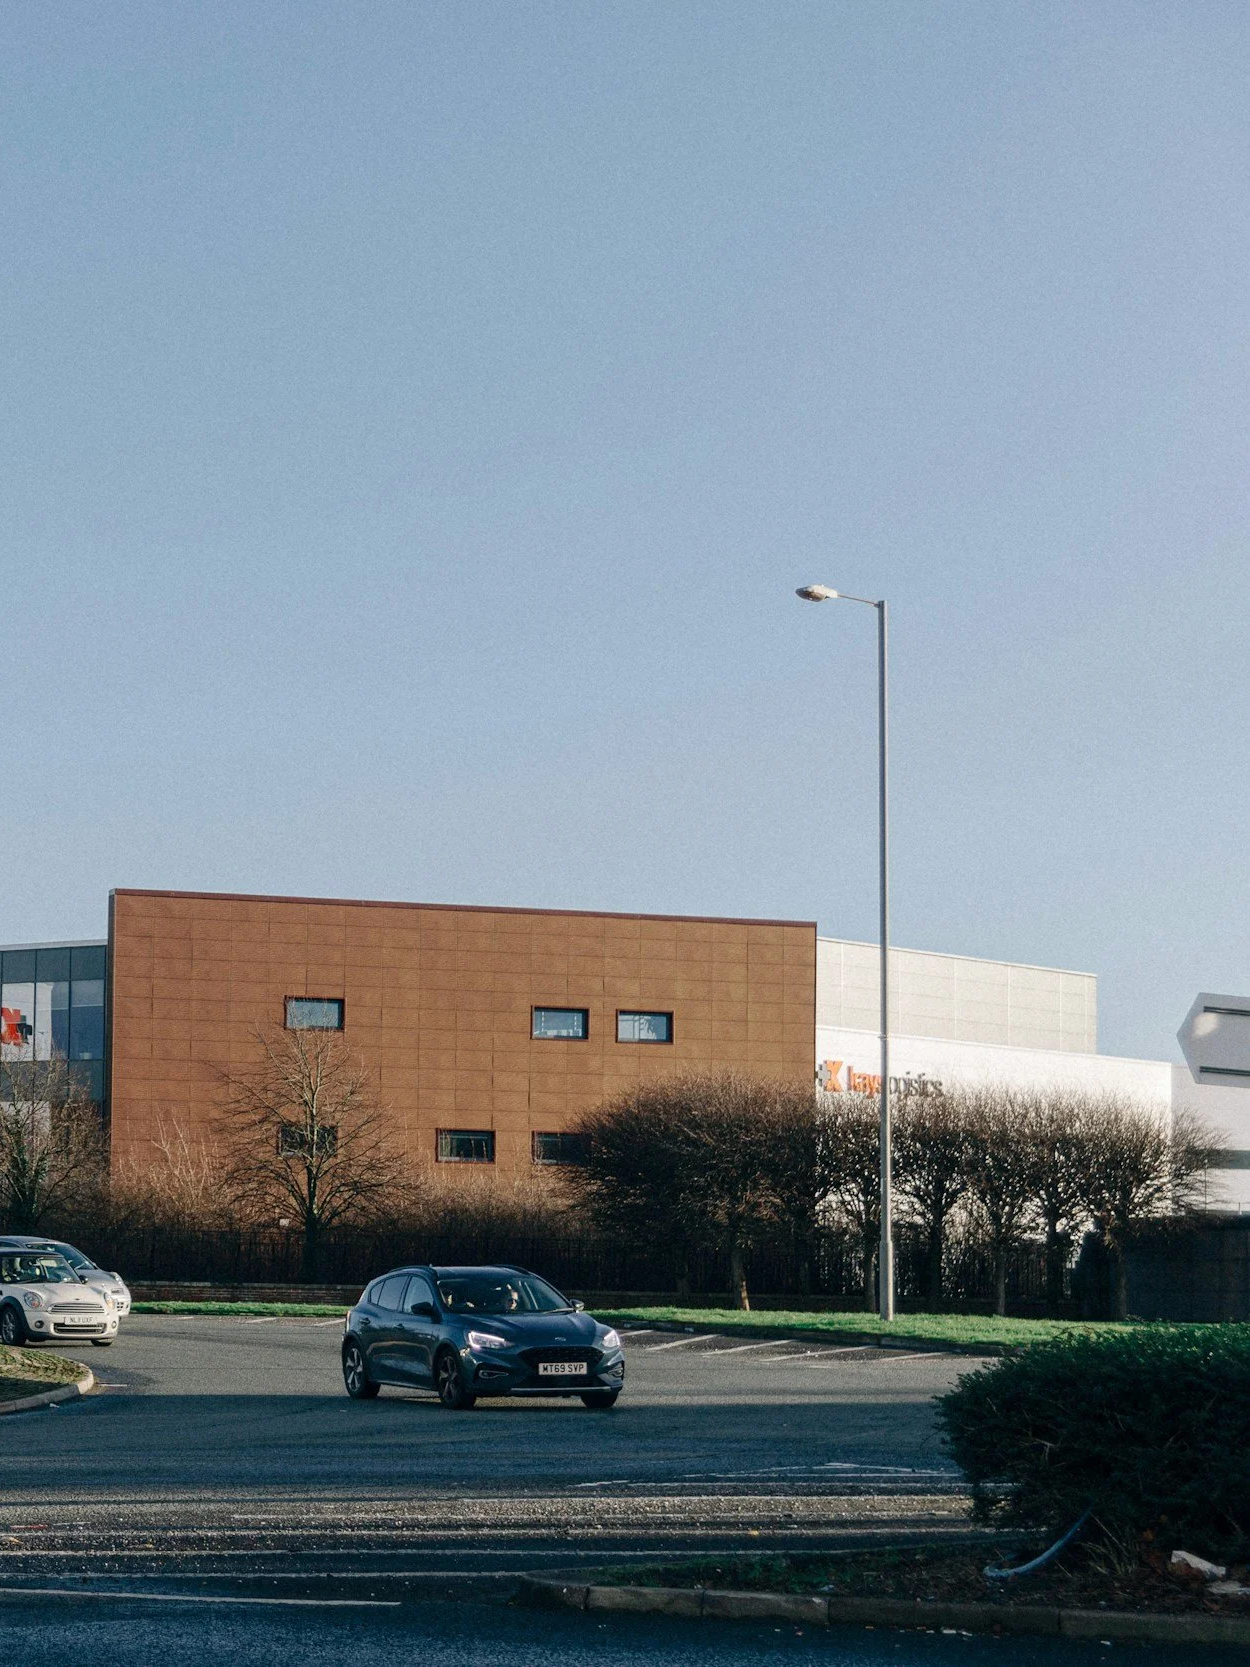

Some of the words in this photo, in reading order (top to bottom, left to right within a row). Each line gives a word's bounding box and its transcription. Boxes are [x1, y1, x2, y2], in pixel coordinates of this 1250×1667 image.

[846, 1065, 943, 1100] kaysogistics
[542, 1364, 566, 1373] MT69
[567, 1364, 584, 1373] SVP
